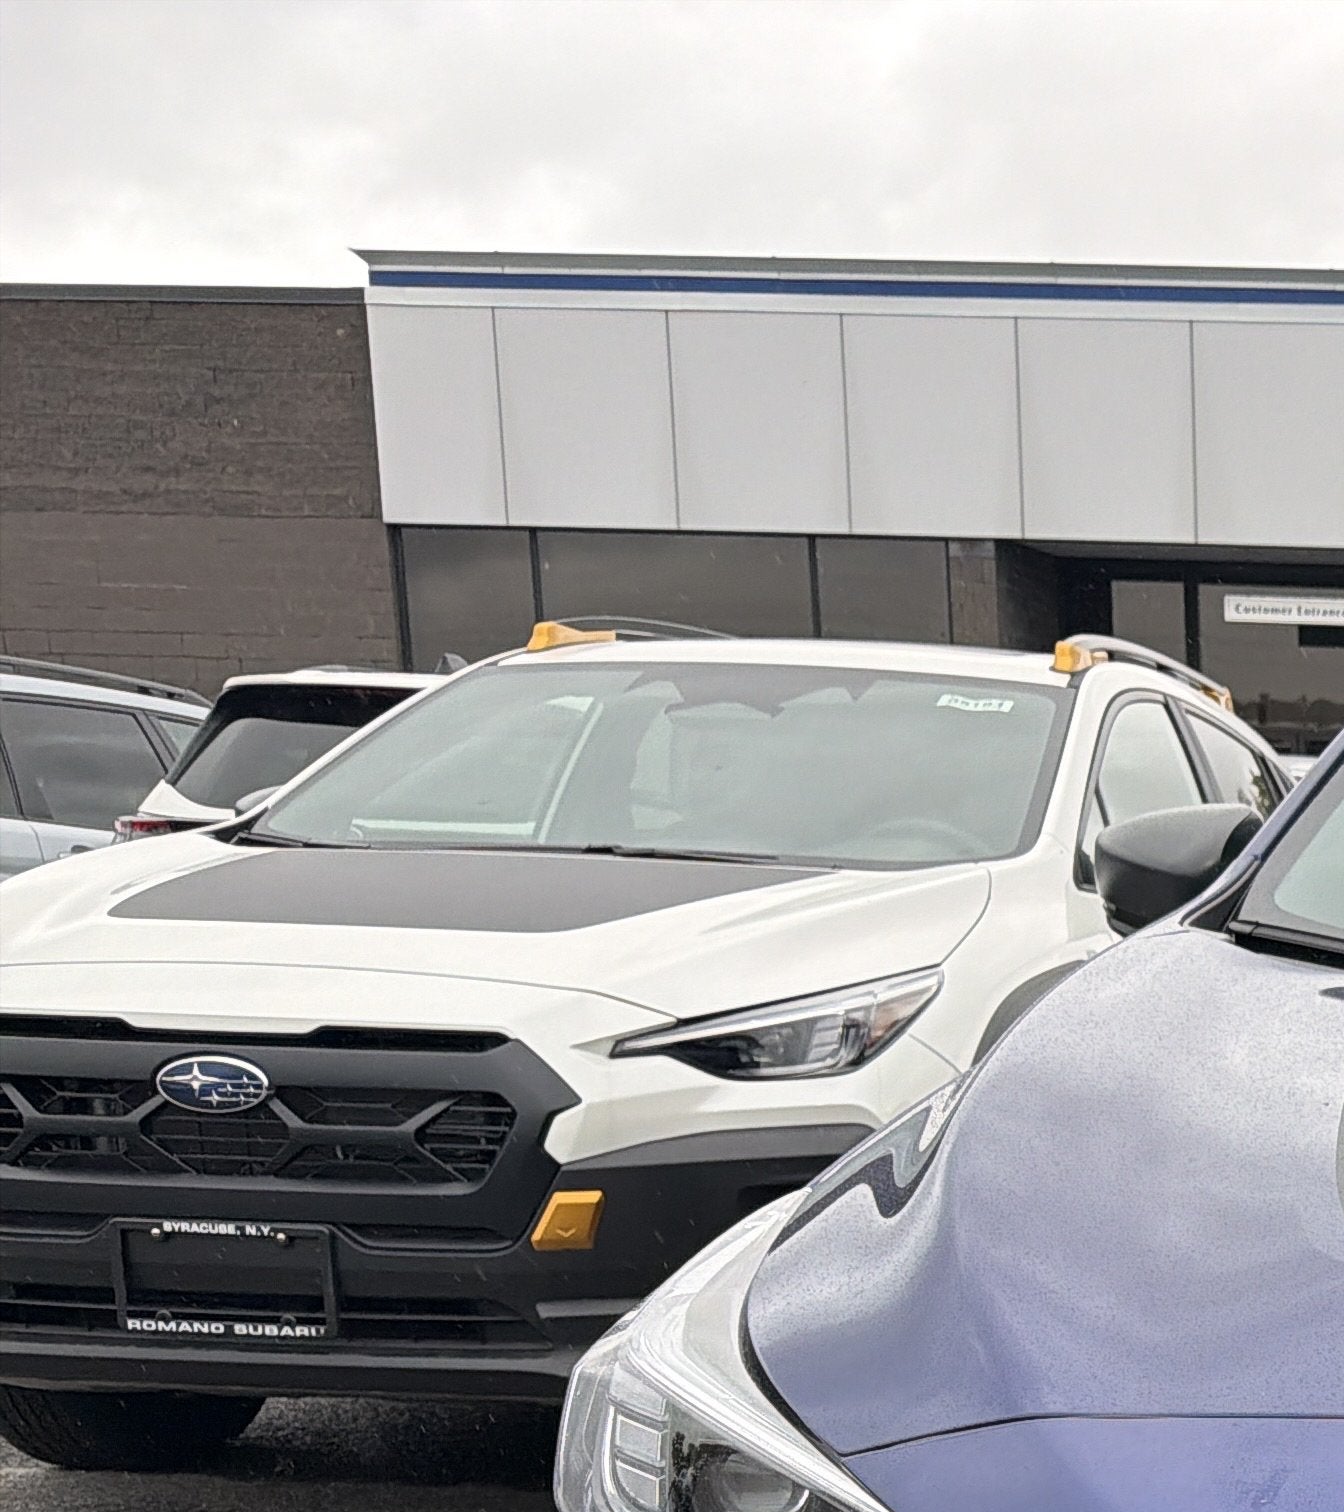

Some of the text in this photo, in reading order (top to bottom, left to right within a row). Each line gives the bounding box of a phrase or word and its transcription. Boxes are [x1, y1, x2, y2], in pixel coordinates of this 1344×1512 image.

[1234, 603, 1292, 616] Customer
[163, 1221, 275, 1236] SYRACUSE, N.Y.
[127, 1318, 225, 1333] ROMANO
